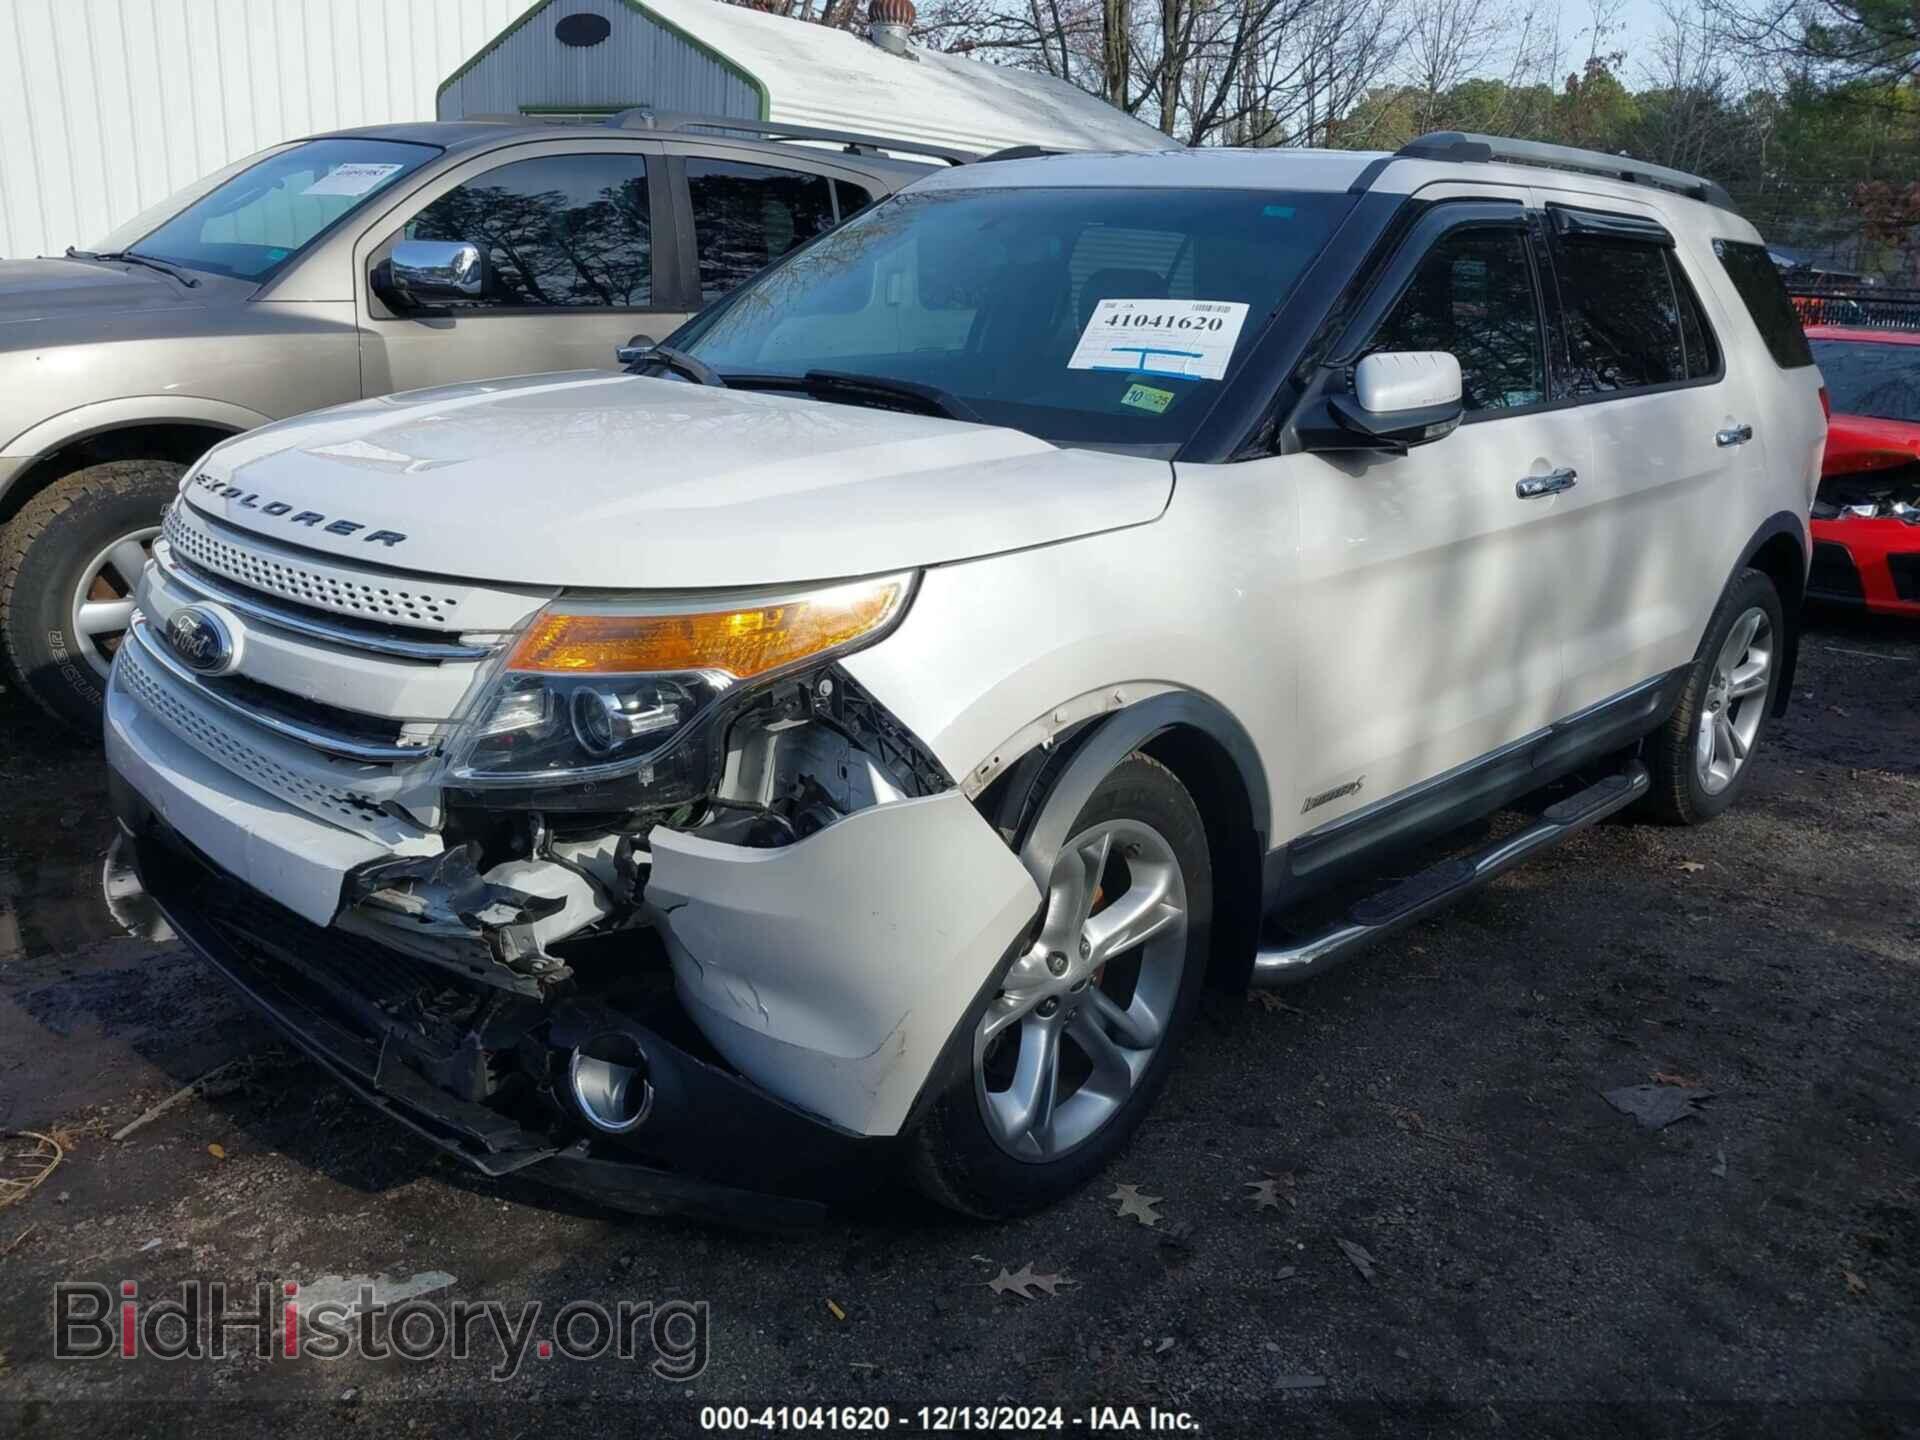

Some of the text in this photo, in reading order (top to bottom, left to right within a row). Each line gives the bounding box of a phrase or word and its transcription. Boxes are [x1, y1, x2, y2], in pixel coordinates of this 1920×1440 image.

[1105, 313, 1223, 332] 41041620
[1129, 390, 1144, 402] 10
[195, 473, 408, 547] EXPLORER
[173, 615, 209, 657] Ford
